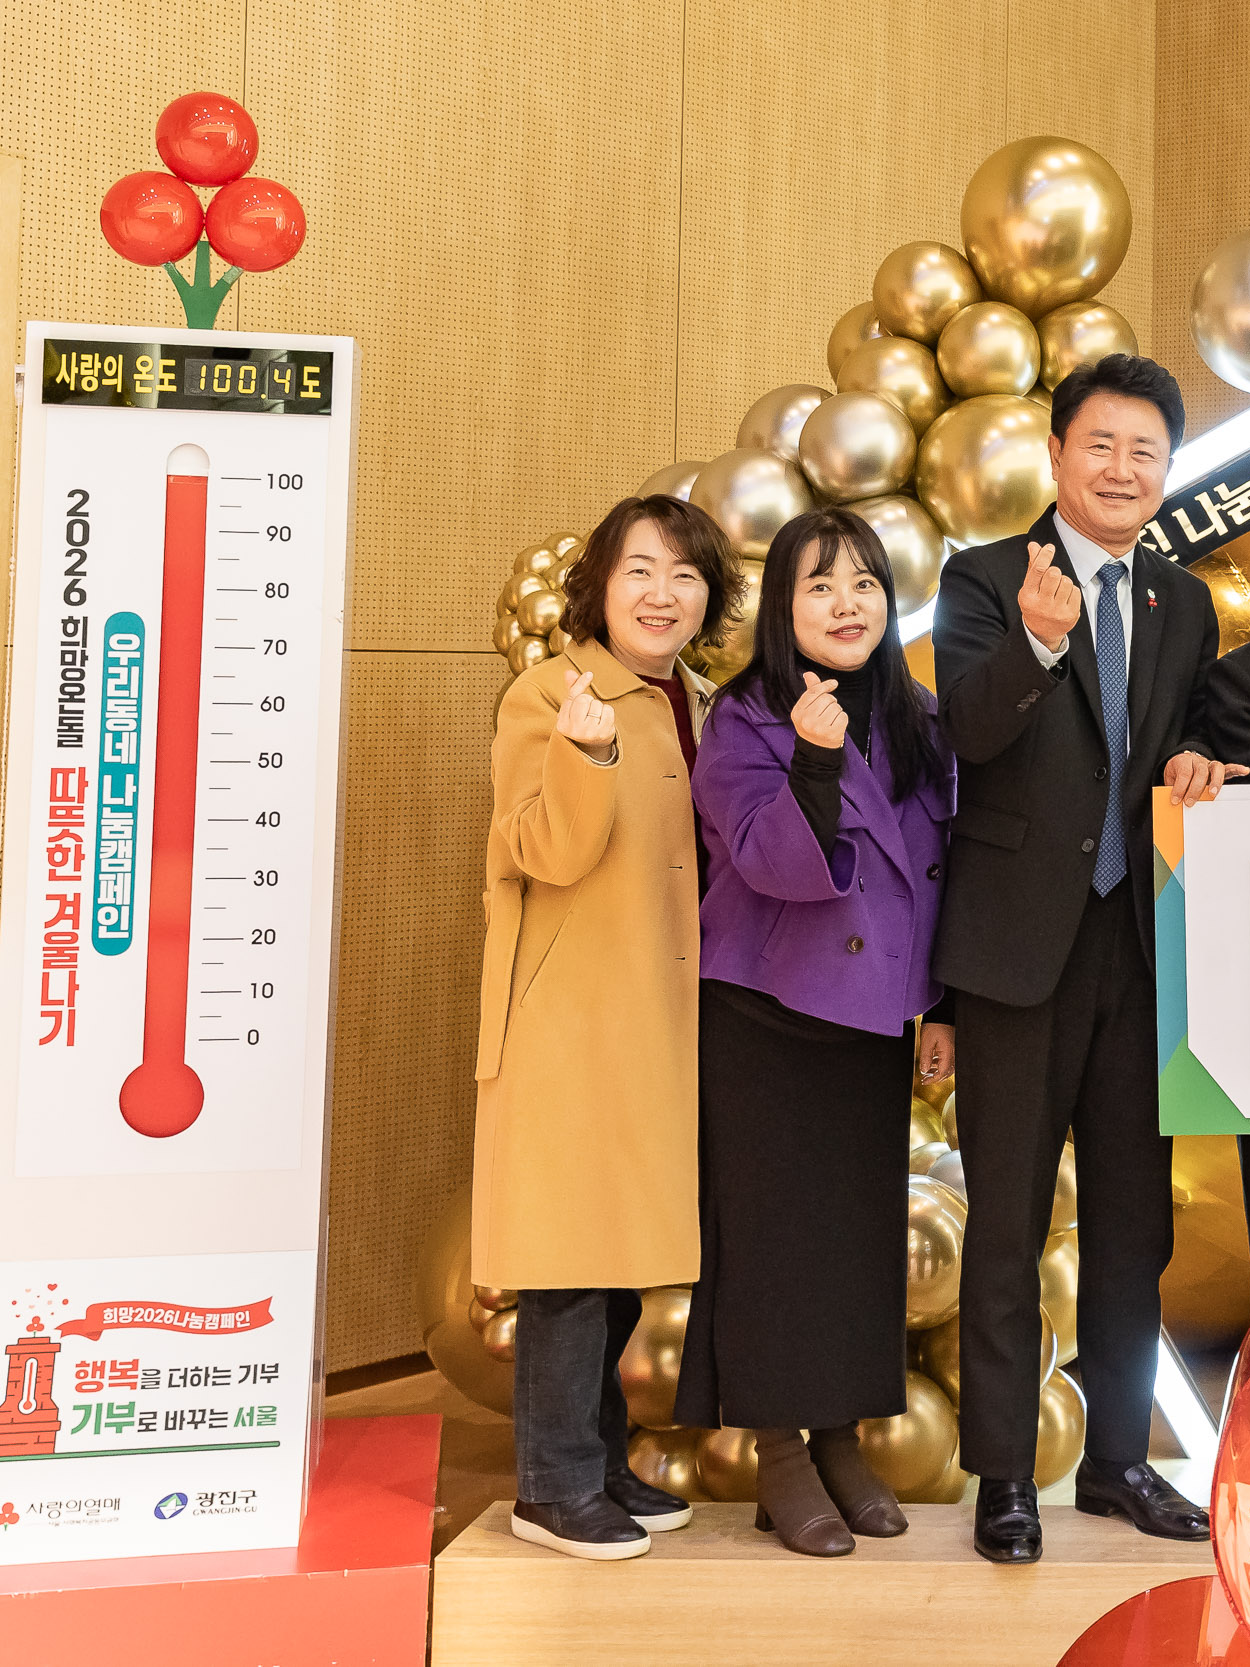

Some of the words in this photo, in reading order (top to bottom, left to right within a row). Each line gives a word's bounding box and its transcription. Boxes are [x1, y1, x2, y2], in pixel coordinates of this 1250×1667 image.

[55, 352, 123, 393] 사랑의
[133, 355, 177, 393] 온도
[199, 363, 291, 400] 100.4
[300, 365, 322, 399] 도
[266, 473, 303, 490] 100
[266, 525, 292, 542] 90
[63, 489, 90, 607] 2026
[264, 582, 290, 599] 80
[263, 639, 287, 655] 70
[57, 616, 89, 748] 희망온돌
[103, 633, 141, 764] 우리동네
[260, 696, 286, 713] 60
[257, 752, 283, 769] 50
[46, 766, 89, 881] 따뜻한
[255, 811, 281, 828] 40
[97, 773, 137, 939] 나눔캠페인
[253, 870, 279, 887] 30
[251, 929, 276, 945] 20
[38, 892, 81, 1047] 겨울나기
[250, 983, 274, 999] 10
[247, 1029, 260, 1046] 0
[102, 1307, 251, 1330] 희망2026나눔캠페인
[74, 1358, 161, 1393] 행복을
[168, 1365, 231, 1389] 더하는
[238, 1362, 280, 1385] 기부
[70, 1401, 157, 1435] 기부로
[164, 1408, 228, 1431] 바꾸는
[233, 1405, 278, 1428] 서울
[195, 1490, 257, 1507] 광진구
[26, 1498, 121, 1519] 사랑의열매
